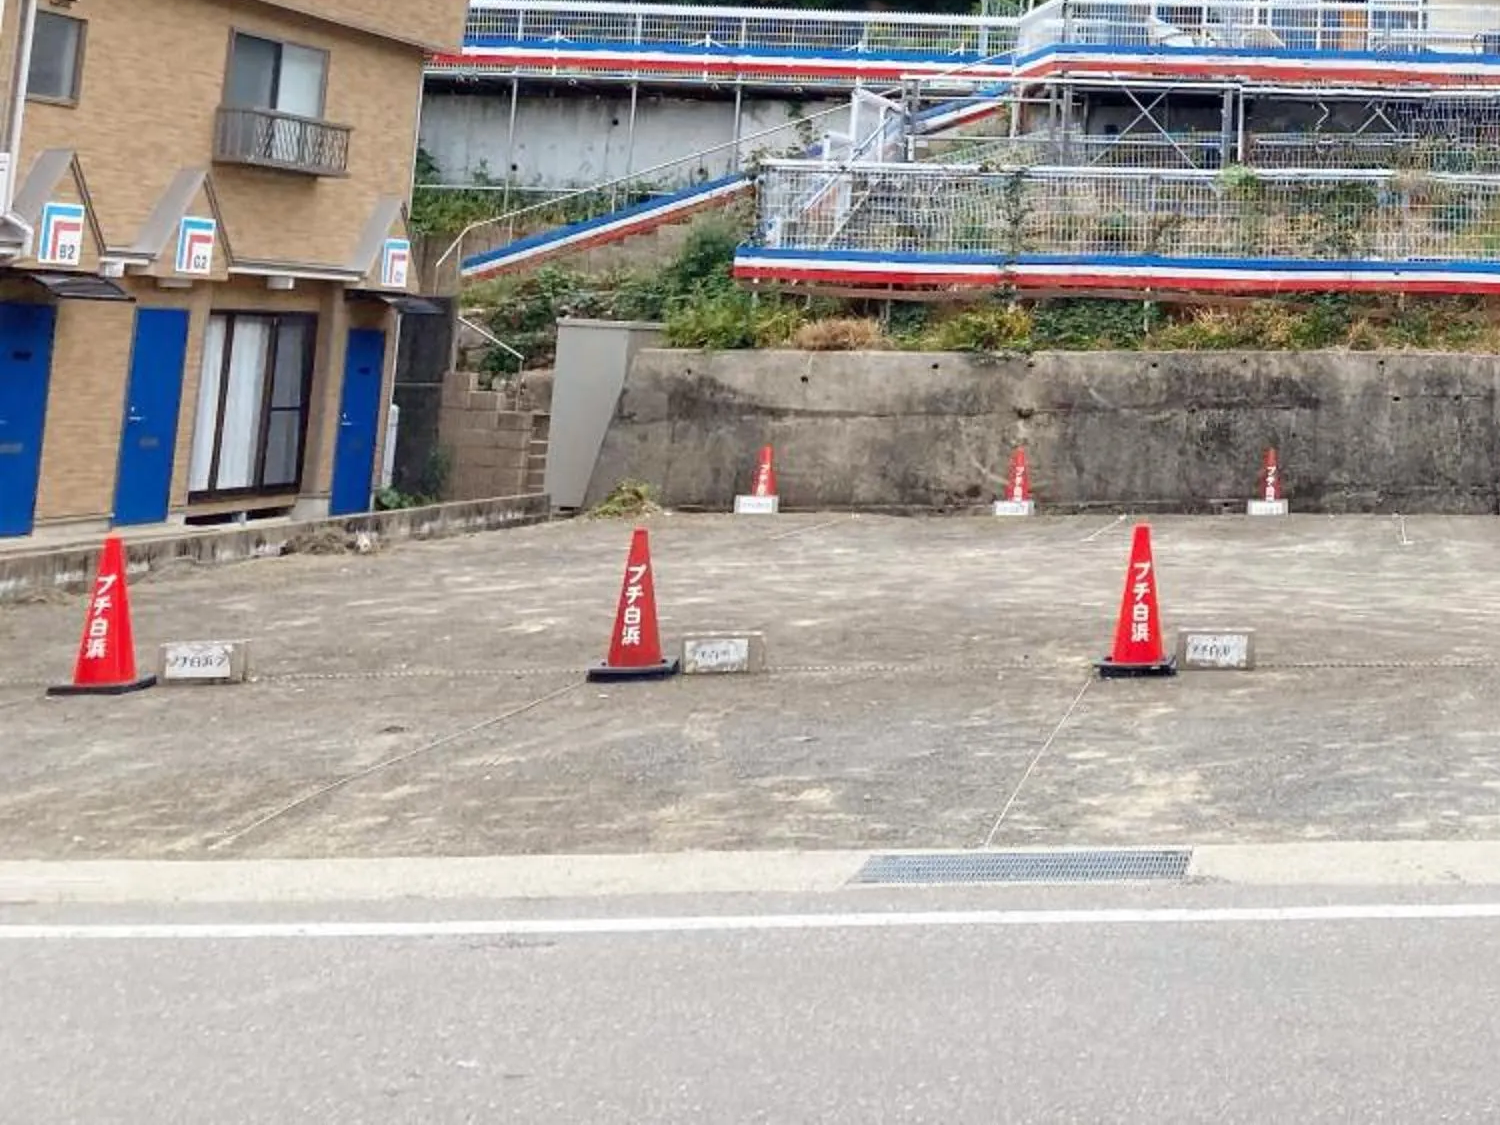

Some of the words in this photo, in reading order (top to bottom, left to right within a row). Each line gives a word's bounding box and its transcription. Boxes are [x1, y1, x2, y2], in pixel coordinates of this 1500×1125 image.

[86, 574, 117, 659] プチ白浜
[621, 564, 647, 646] プチ白浜
[1131, 561, 1151, 642] プチ白浜
